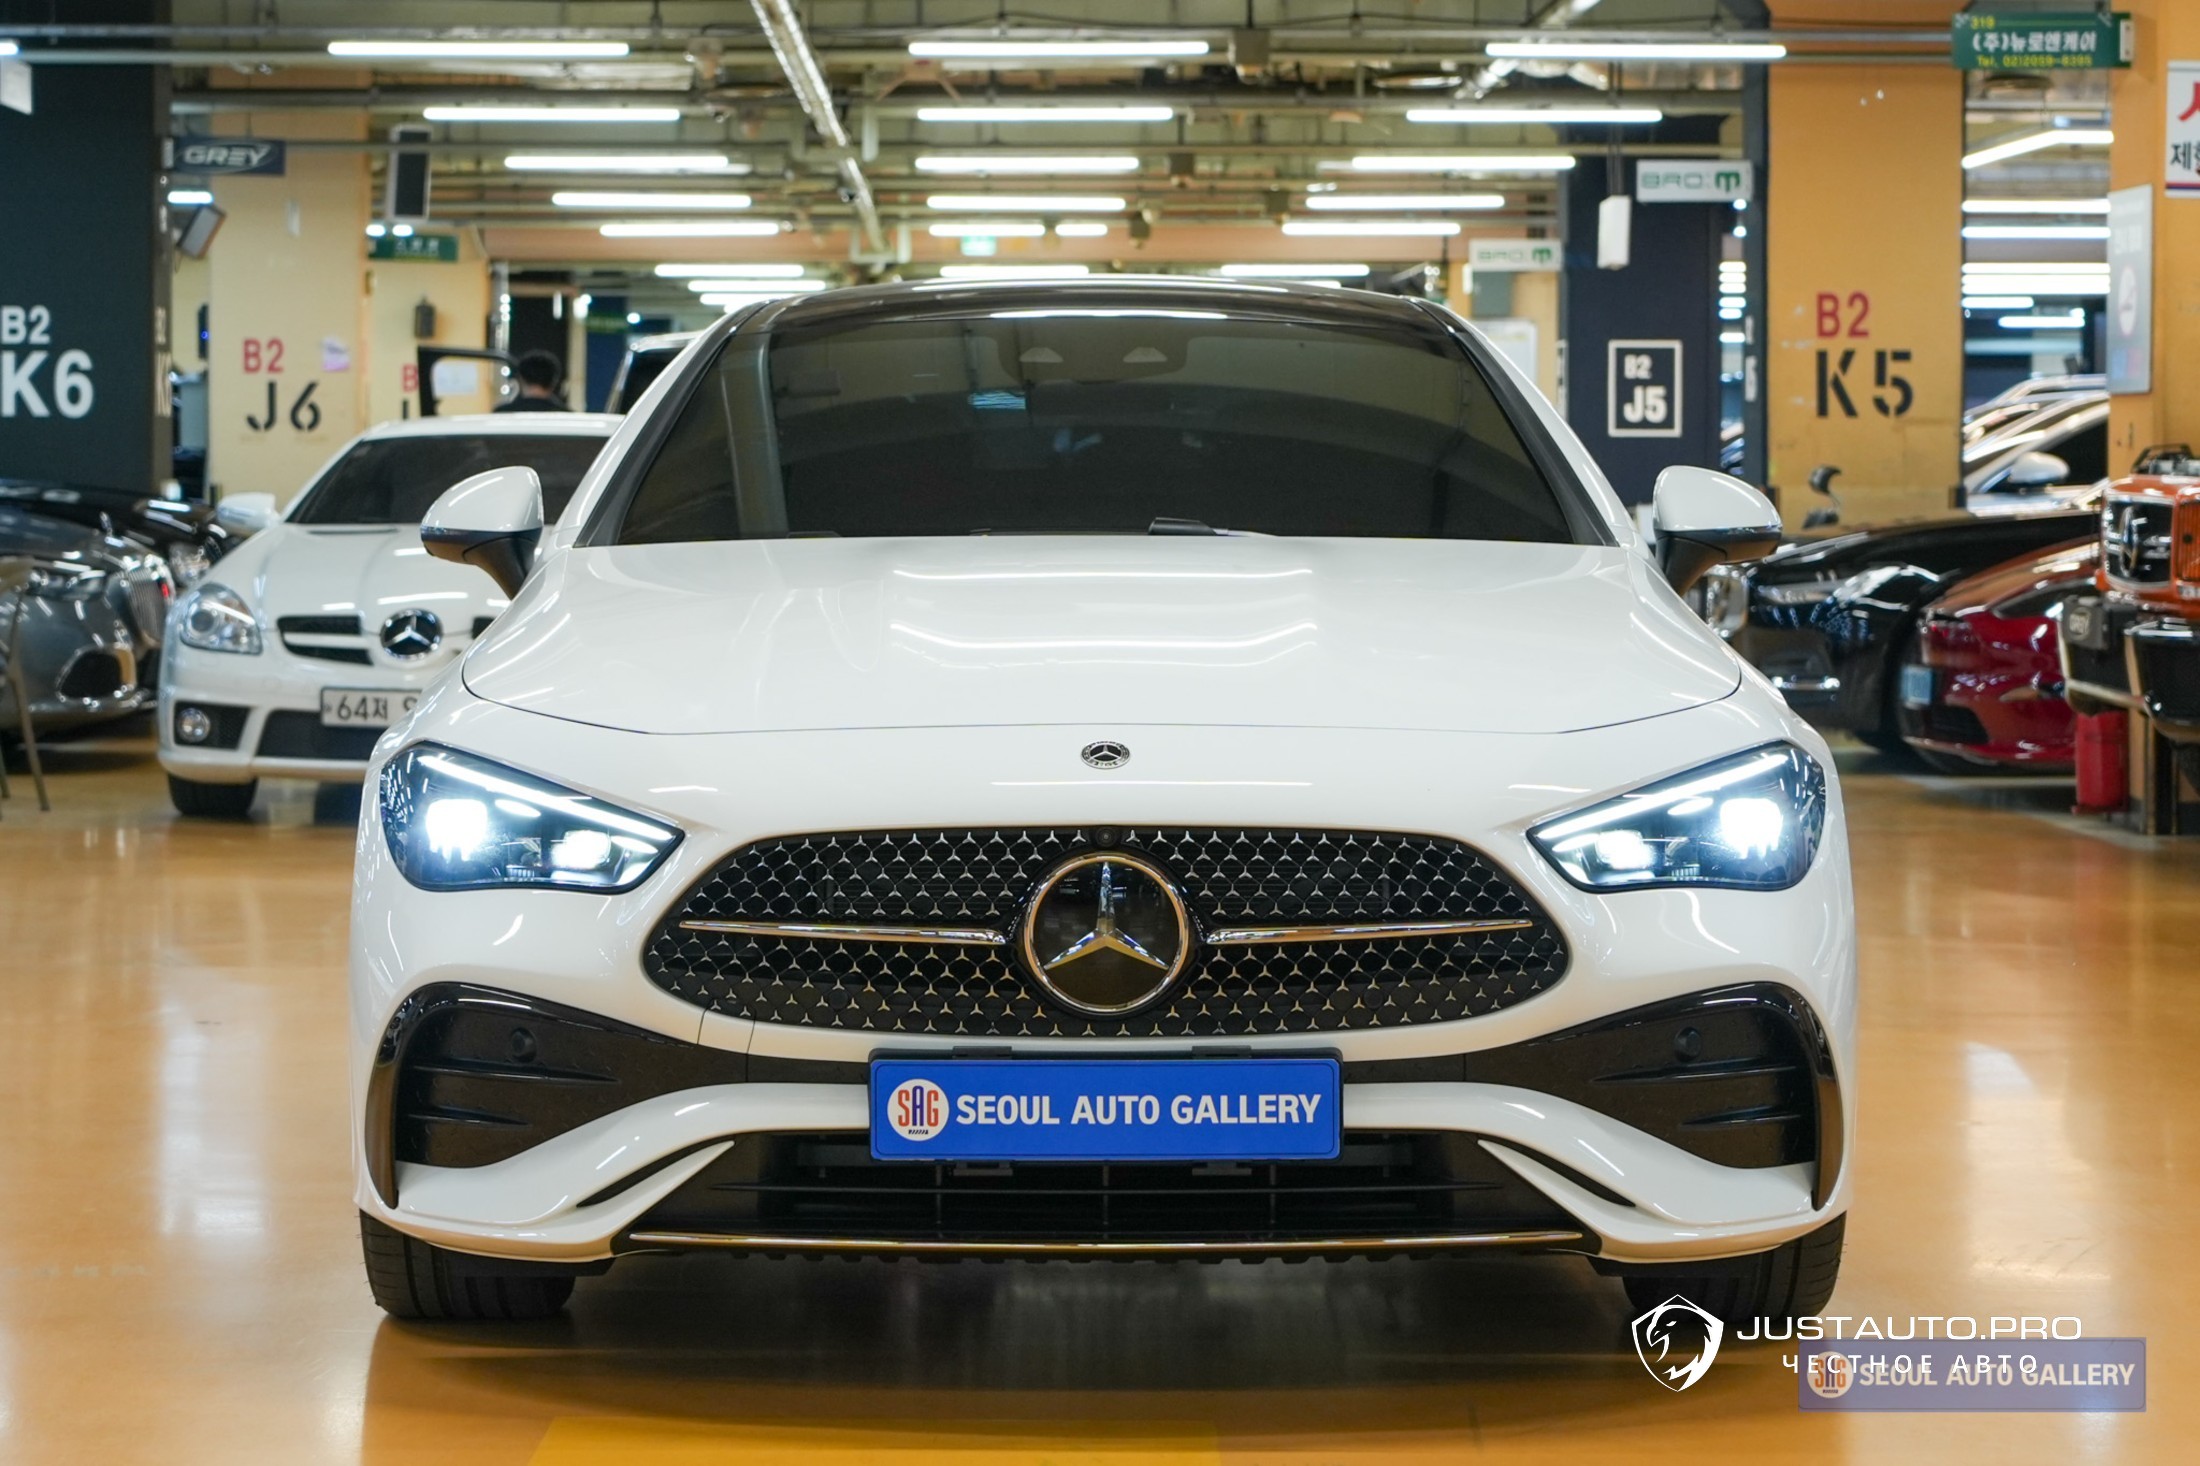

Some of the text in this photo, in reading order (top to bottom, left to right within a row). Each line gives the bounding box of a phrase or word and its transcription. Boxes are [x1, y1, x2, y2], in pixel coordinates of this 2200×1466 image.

[184, 143, 271, 167] GREY
[1, 305, 50, 344] B2
[1817, 292, 1870, 338] B2
[243, 338, 285, 374] B2
[1624, 355, 1652, 379] B2
[1, 349, 93, 419] K6
[1816, 350, 1913, 417] K5
[246, 380, 322, 432] J6
[1623, 385, 1667, 422] J5
[898, 1085, 939, 1127] SAG
[956, 1094, 1321, 1125] SEOUL AUTO GALLERY
